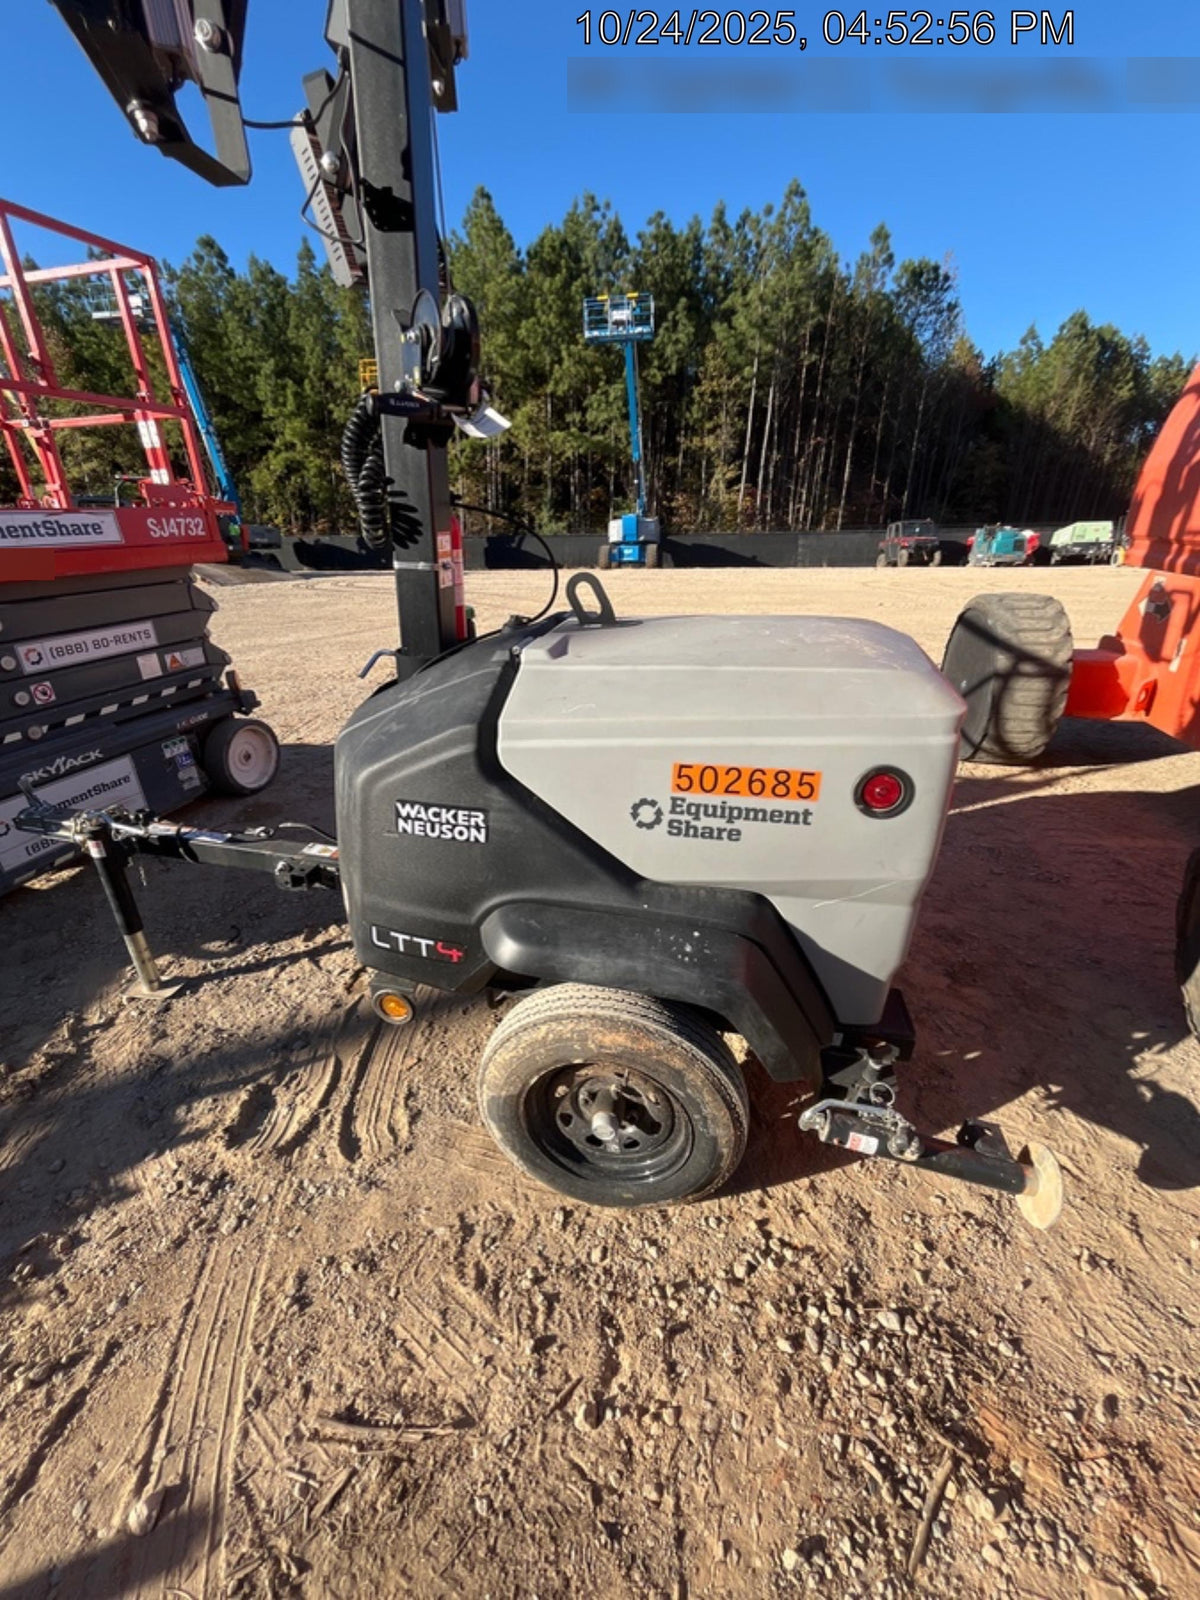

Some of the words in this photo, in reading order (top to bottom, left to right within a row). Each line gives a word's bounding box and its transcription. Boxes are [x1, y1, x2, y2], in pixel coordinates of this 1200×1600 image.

[147, 518, 206, 538] SJ4732
[48, 641, 90, 659] (888)
[53, 774, 131, 811] mentShare
[676, 764, 816, 799] 502685
[396, 802, 486, 828] WACKER
[669, 797, 813, 825] Equipment
[398, 819, 486, 843] NEUSON
[667, 819, 742, 841] Share
[372, 926, 463, 963] LTT4
